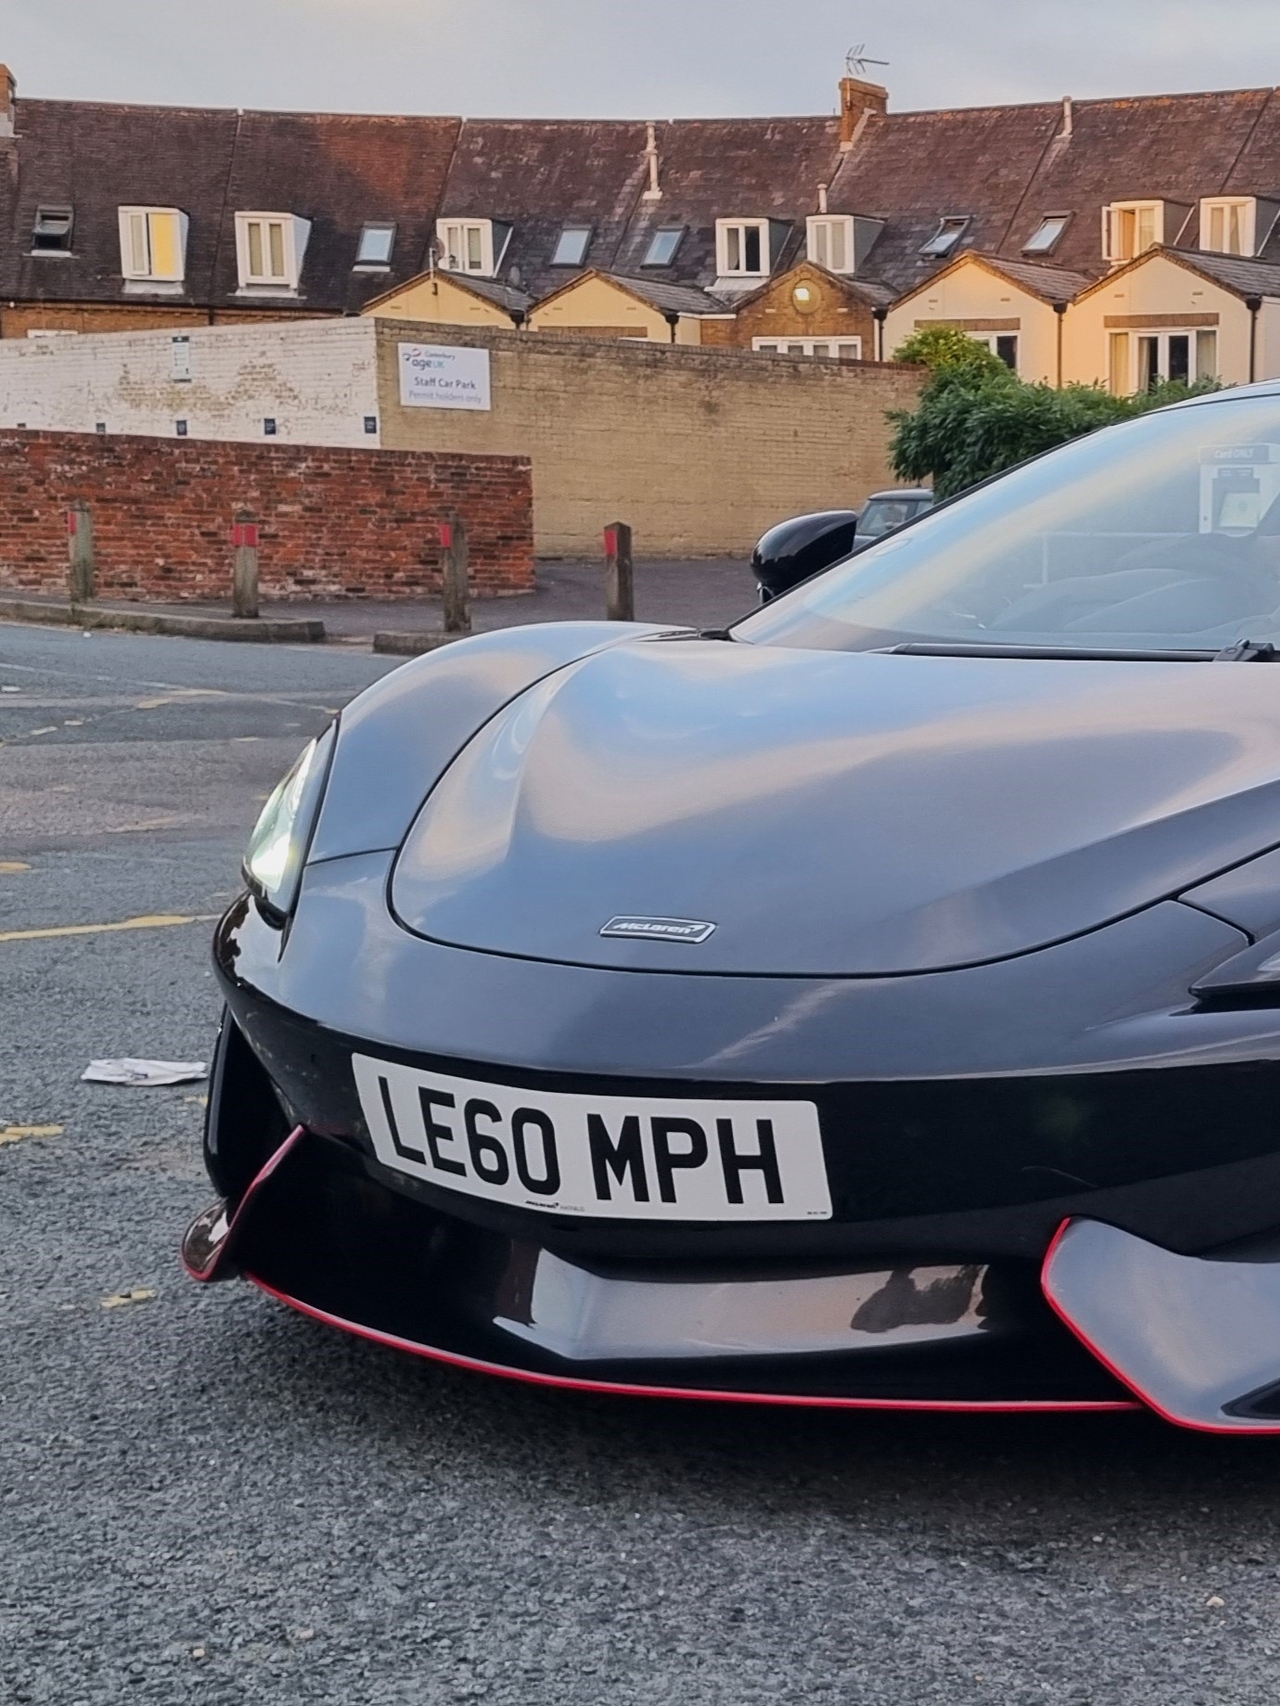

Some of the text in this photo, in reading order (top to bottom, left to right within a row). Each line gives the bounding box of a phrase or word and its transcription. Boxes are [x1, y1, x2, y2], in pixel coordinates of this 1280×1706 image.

[414, 376, 476, 390] Staff Car Park
[409, 390, 433, 399] Permit
[466, 395, 482, 404] only
[378, 1076, 784, 1204] LE60 MPH
